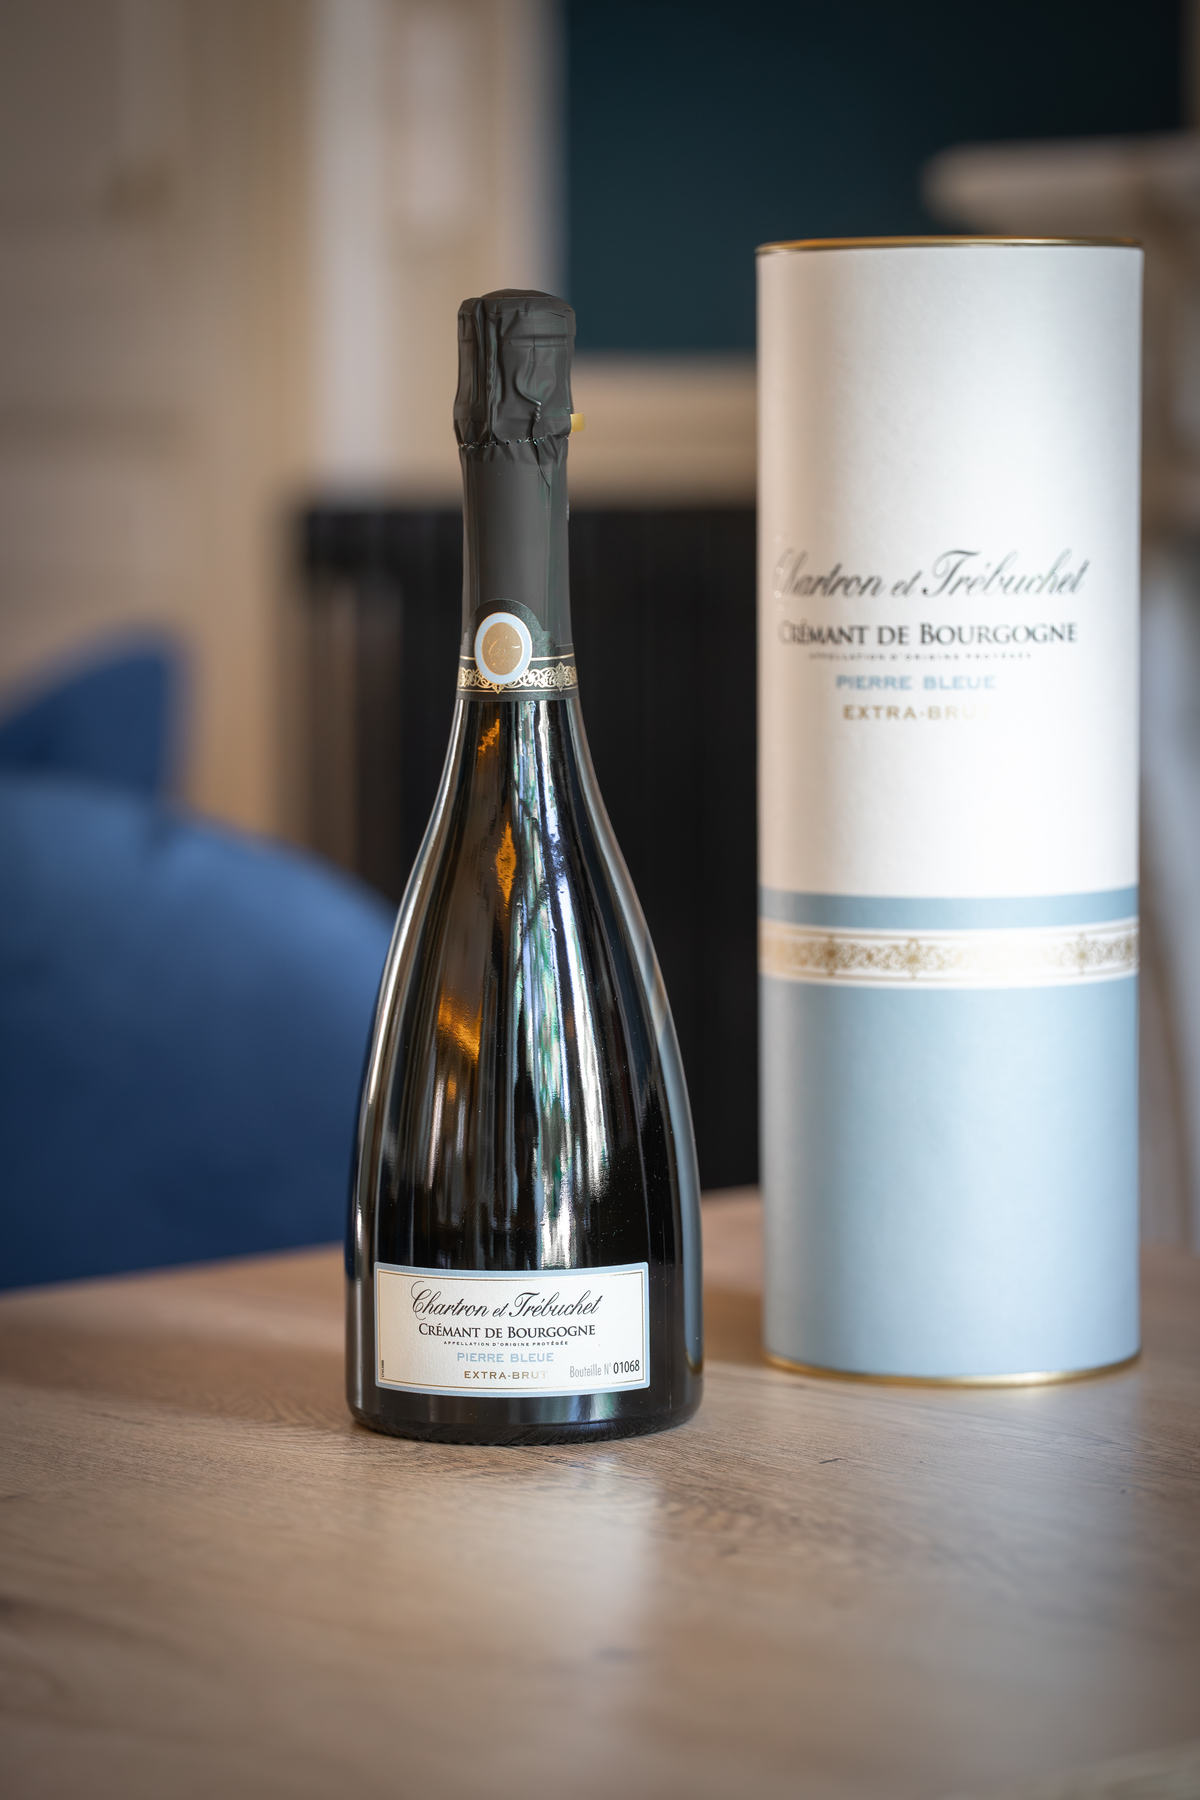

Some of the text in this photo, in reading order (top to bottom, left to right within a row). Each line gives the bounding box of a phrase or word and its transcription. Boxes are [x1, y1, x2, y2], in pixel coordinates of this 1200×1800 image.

[890, 568, 922, 598] et
[922, 548, 1091, 597] Trébuchet
[877, 624, 911, 646] DE
[919, 621, 1079, 646] BOURGOGNE
[836, 674, 998, 691] PIERRE BLEUE
[411, 1280, 604, 1320] Chartron et Trébuchet
[418, 1323, 596, 1339] CRÉMANT DE BOURGOGNE
[457, 1352, 555, 1363] PIERRE BLEUE
[464, 1370, 548, 1380] EXTRA-BRUT
[570, 1363, 602, 1378] Bouteille
[613, 1359, 640, 1375] 01068
